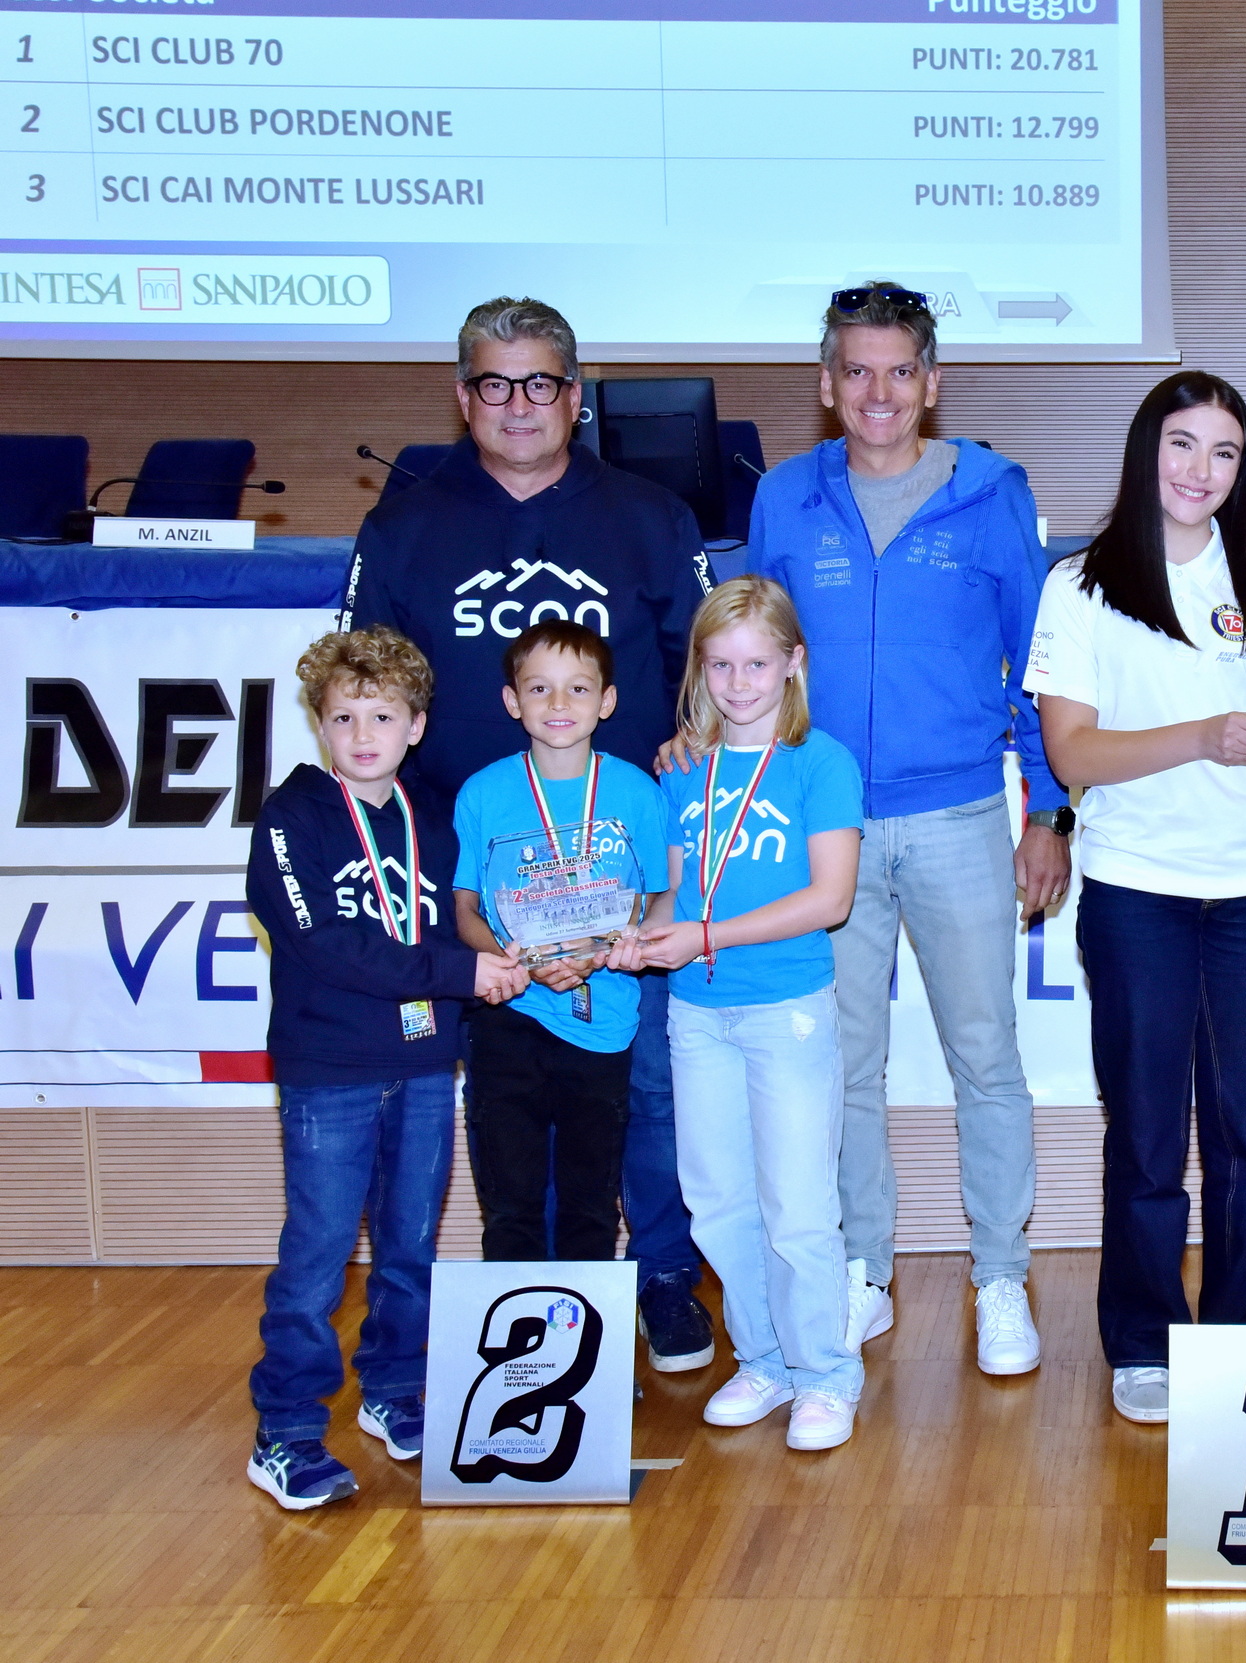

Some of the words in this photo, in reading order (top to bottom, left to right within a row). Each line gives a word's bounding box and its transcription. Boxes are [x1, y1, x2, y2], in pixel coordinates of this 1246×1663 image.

[15, 35, 34, 62] 1
[92, 36, 141, 64] SCI
[151, 37, 234, 65] CLUB
[244, 38, 284, 66] 70
[912, 48, 1002, 71] PUNTI:
[1010, 48, 1099, 72] 20.781
[20, 105, 41, 133] 2
[97, 106, 145, 134] SCI
[156, 107, 239, 135] CLUB
[250, 109, 454, 137] PORDENONE
[913, 116, 1003, 139] PUNTI:
[1011, 116, 1100, 140] 12.799
[26, 174, 46, 202] 3
[102, 175, 149, 203] SCI
[160, 176, 213, 203] CAI
[224, 177, 344, 205] MONTE
[355, 178, 485, 206] LUSSARI
[914, 183, 1003, 207] PUNTI:
[1012, 183, 1100, 208] 10.889
[0, 271, 126, 305] INTESA
[192, 272, 372, 307] SANPAOLO
[138, 527, 160, 541] M.
[165, 528, 213, 542] ANZIL
[346, 553, 363, 607] SPORT
[269, 827, 293, 873] SPORT
[518, 863, 541, 873] GRAN
[542, 860, 561, 870] PRIX
[579, 853, 601, 862] 2025
[564, 878, 619, 894] Classificata
[282, 874, 312, 930] MASTER
[552, 1300, 575, 1310] FISI
[450, 1286, 604, 1484] 2
[469, 1439, 504, 1447] COMITATO
[469, 1447, 491, 1455] FRIULI
